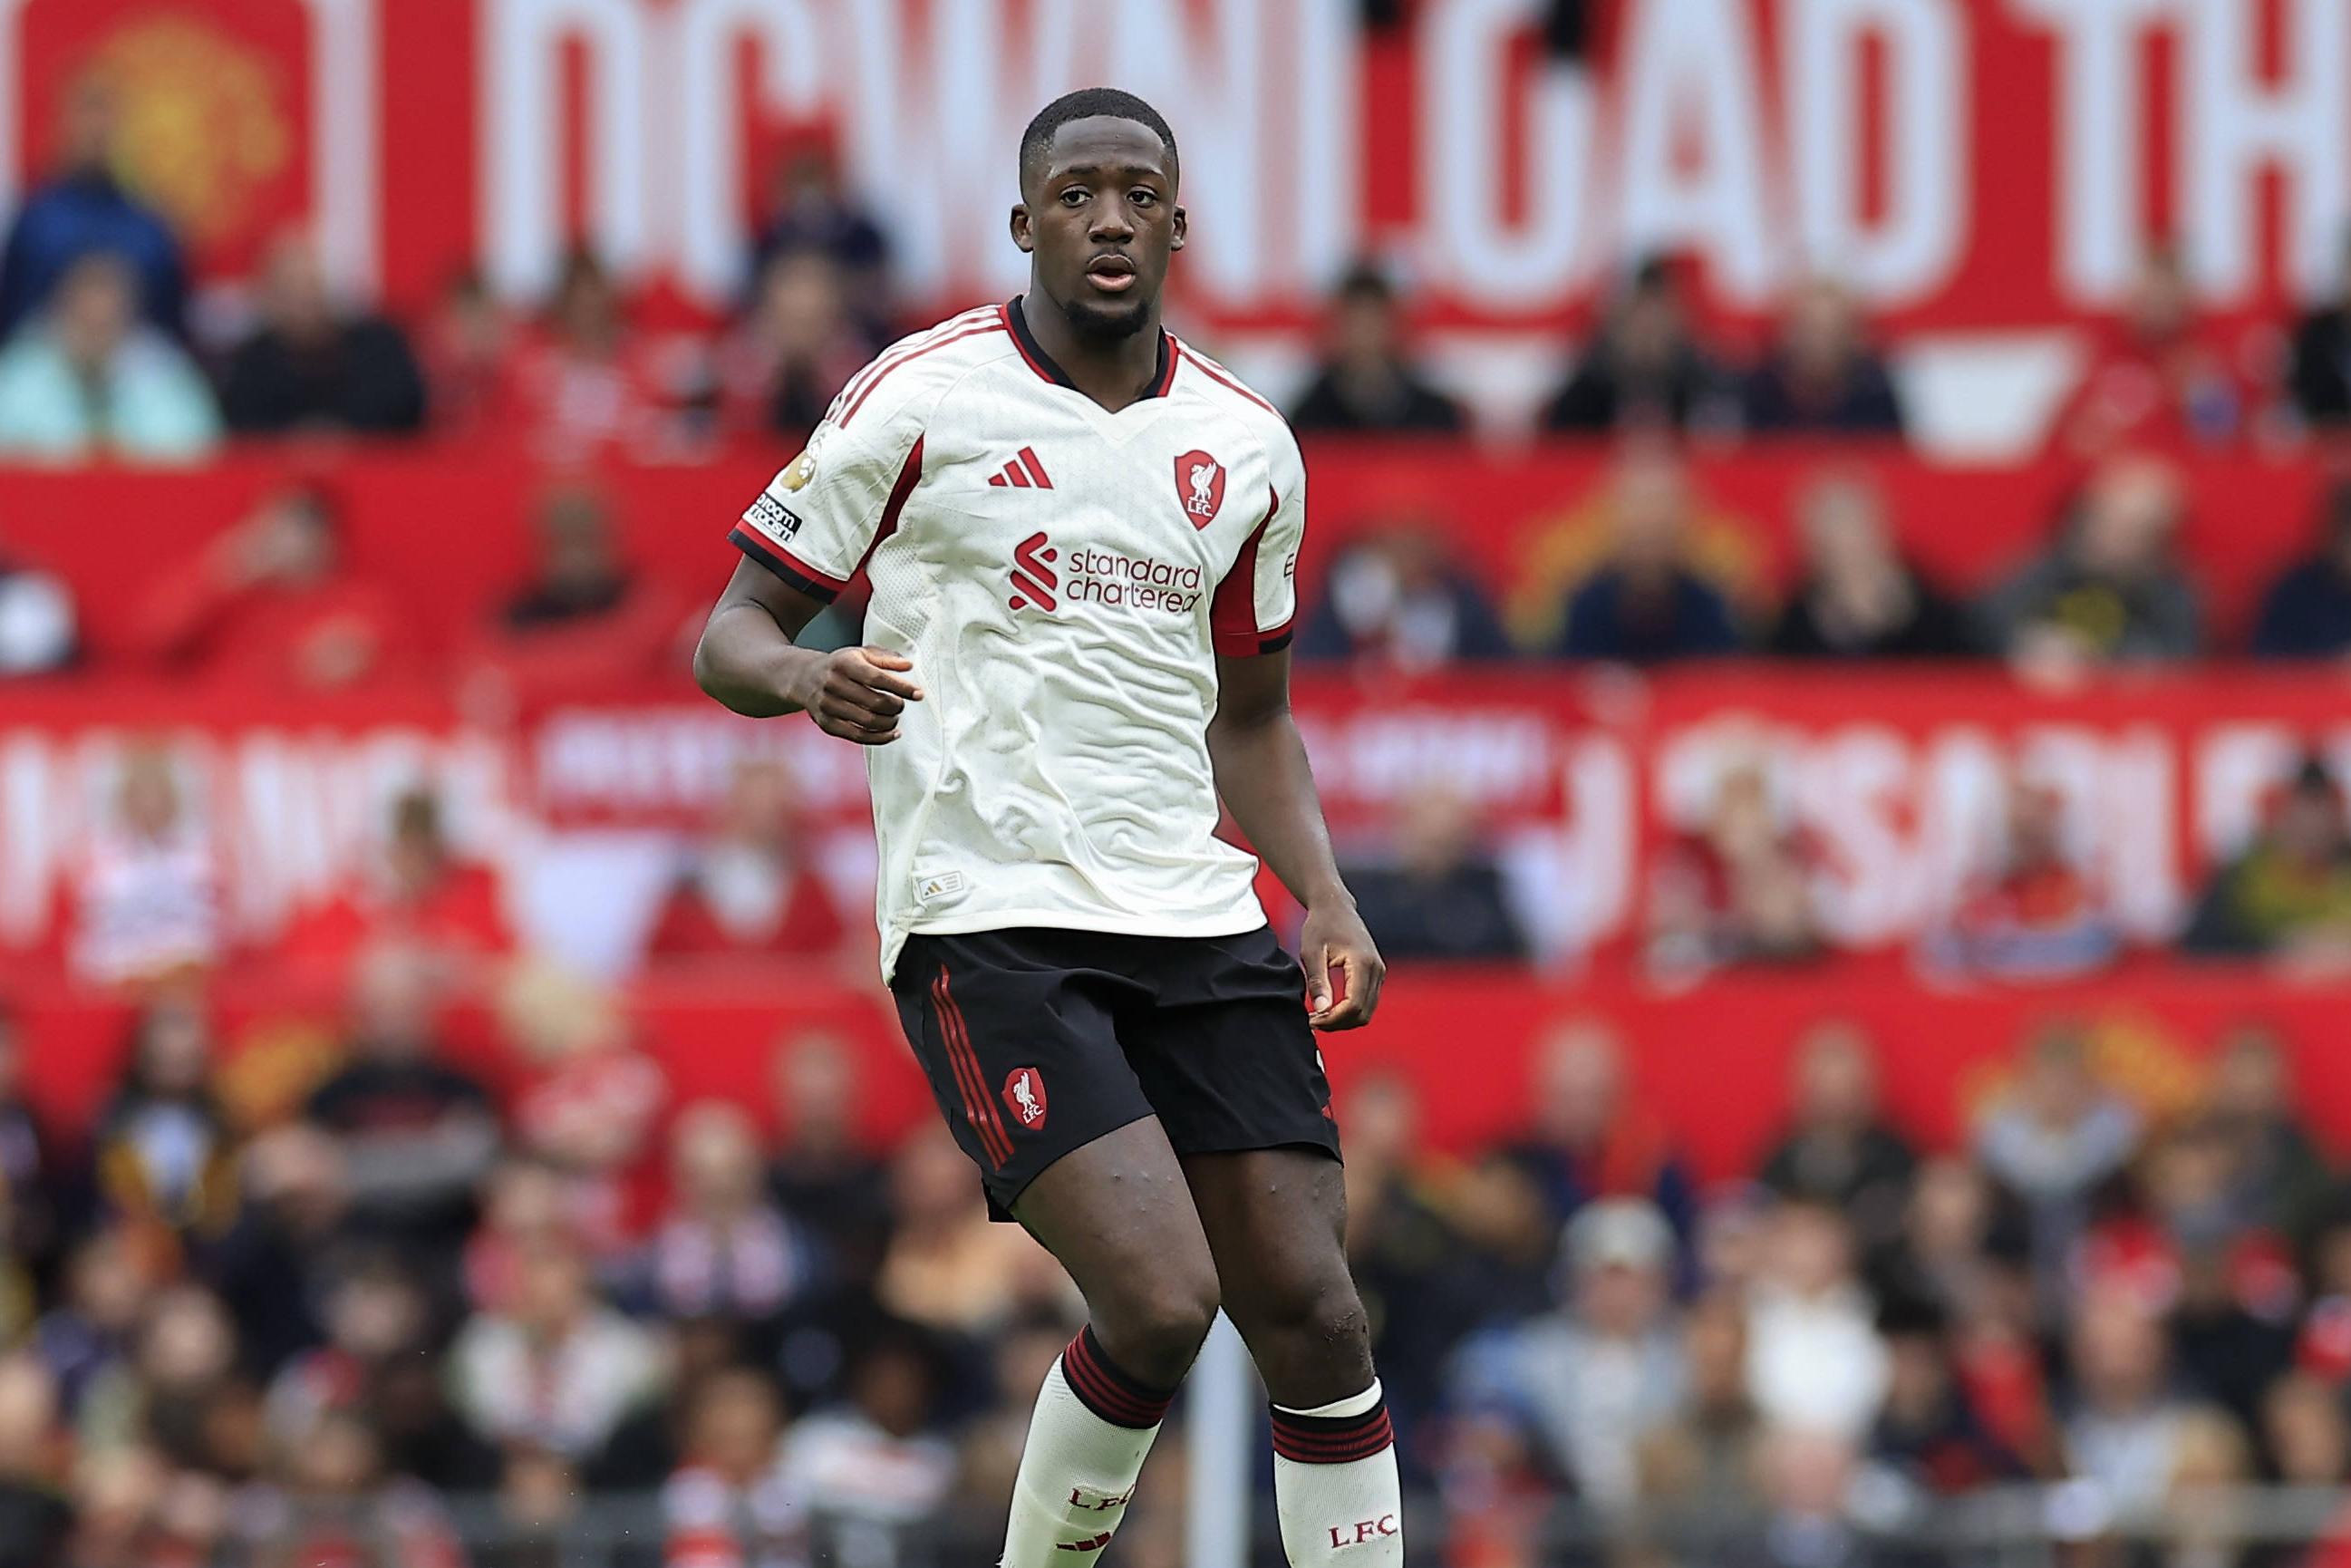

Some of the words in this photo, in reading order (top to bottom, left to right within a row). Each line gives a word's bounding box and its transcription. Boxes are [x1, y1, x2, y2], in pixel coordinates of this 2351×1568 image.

[1069, 548, 1202, 590] standard
[1066, 576, 1203, 614] chartered
[1328, 1515, 1398, 1549] LFC
